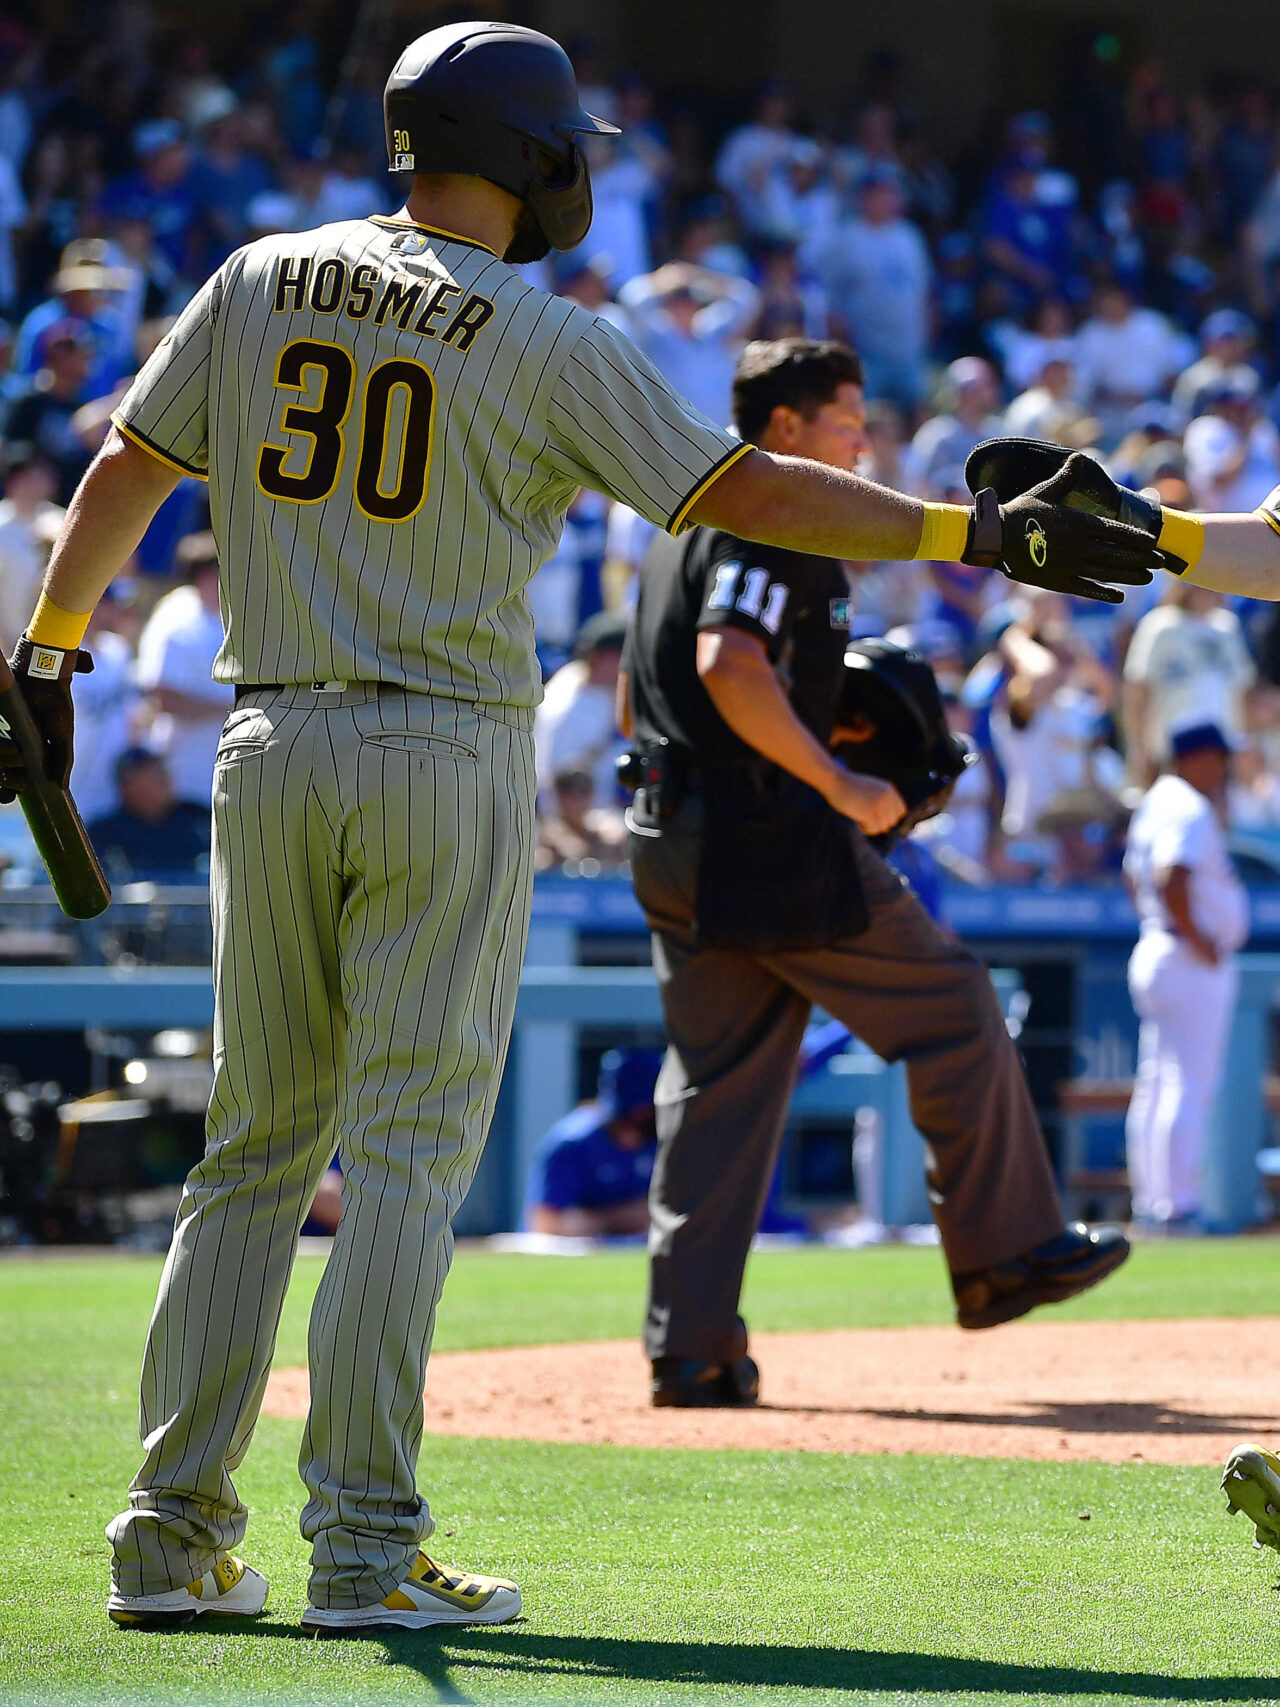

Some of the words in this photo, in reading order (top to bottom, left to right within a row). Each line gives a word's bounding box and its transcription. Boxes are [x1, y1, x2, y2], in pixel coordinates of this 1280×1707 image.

[393, 129, 410, 152] 30
[273, 256, 496, 354] HOSMER
[255, 336, 438, 525] 30
[708, 559, 790, 636] 111
